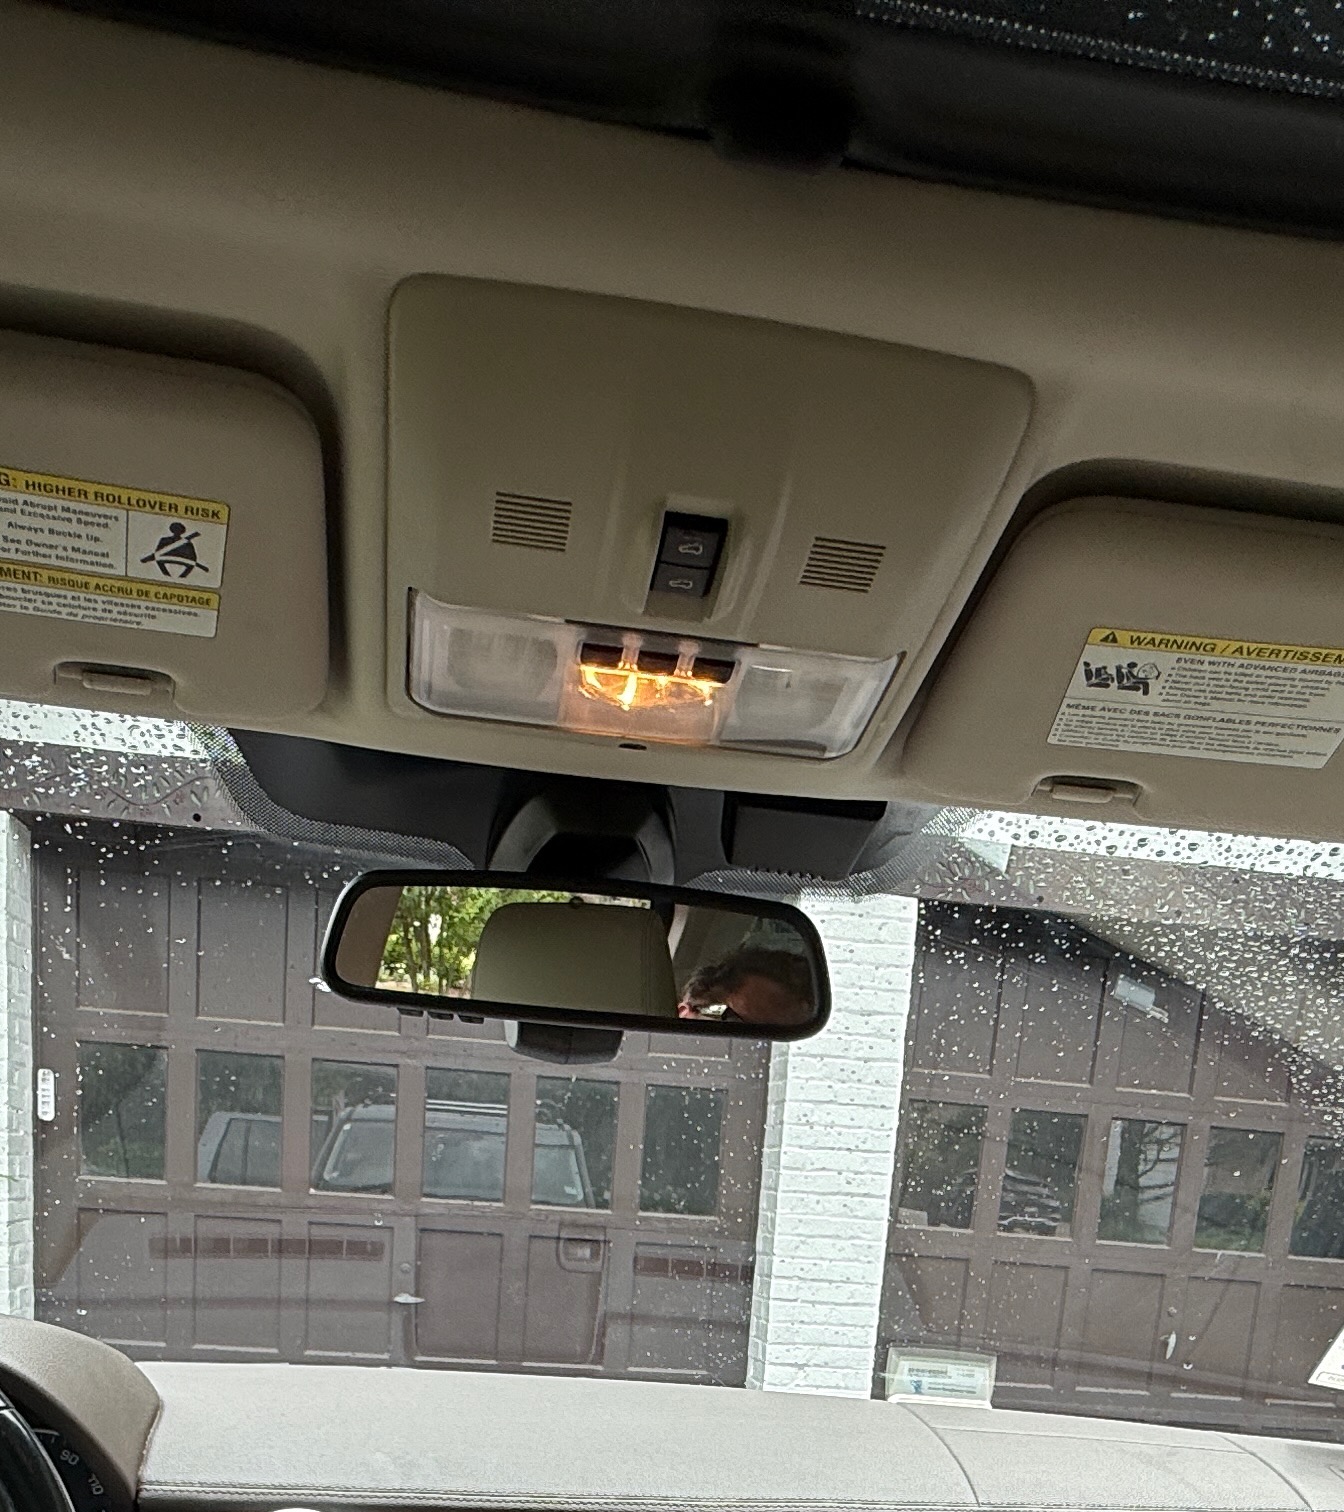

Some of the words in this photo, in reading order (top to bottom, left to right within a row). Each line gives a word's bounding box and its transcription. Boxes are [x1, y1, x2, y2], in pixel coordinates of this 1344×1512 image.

[24, 479, 88, 501] HIGHER
[94, 490, 179, 514] ROLLOVER
[183, 503, 222, 520] RISK
[20, 508, 73, 524] Excessive
[21, 499, 58, 513] Abrupt
[61, 505, 119, 522] Maneuvers
[7, 521, 45, 534] Always
[47, 527, 83, 540] Buckle
[1, 534, 22, 545] See
[71, 545, 109, 558] Manual
[14, 547, 52, 560] Further
[47, 576, 90, 592] RISQUE
[94, 582, 133, 597] ACCRU
[137, 588, 151, 599] DE
[153, 590, 212, 607] CAPOTAGE
[1129, 634, 1216, 654] WARNING
[1207, 660, 1235, 669] WITH
[1238, 663, 1297, 676] ADVANCED
[60, 1449, 79, 1465] 90
[87, 1472, 104, 1495] 110
